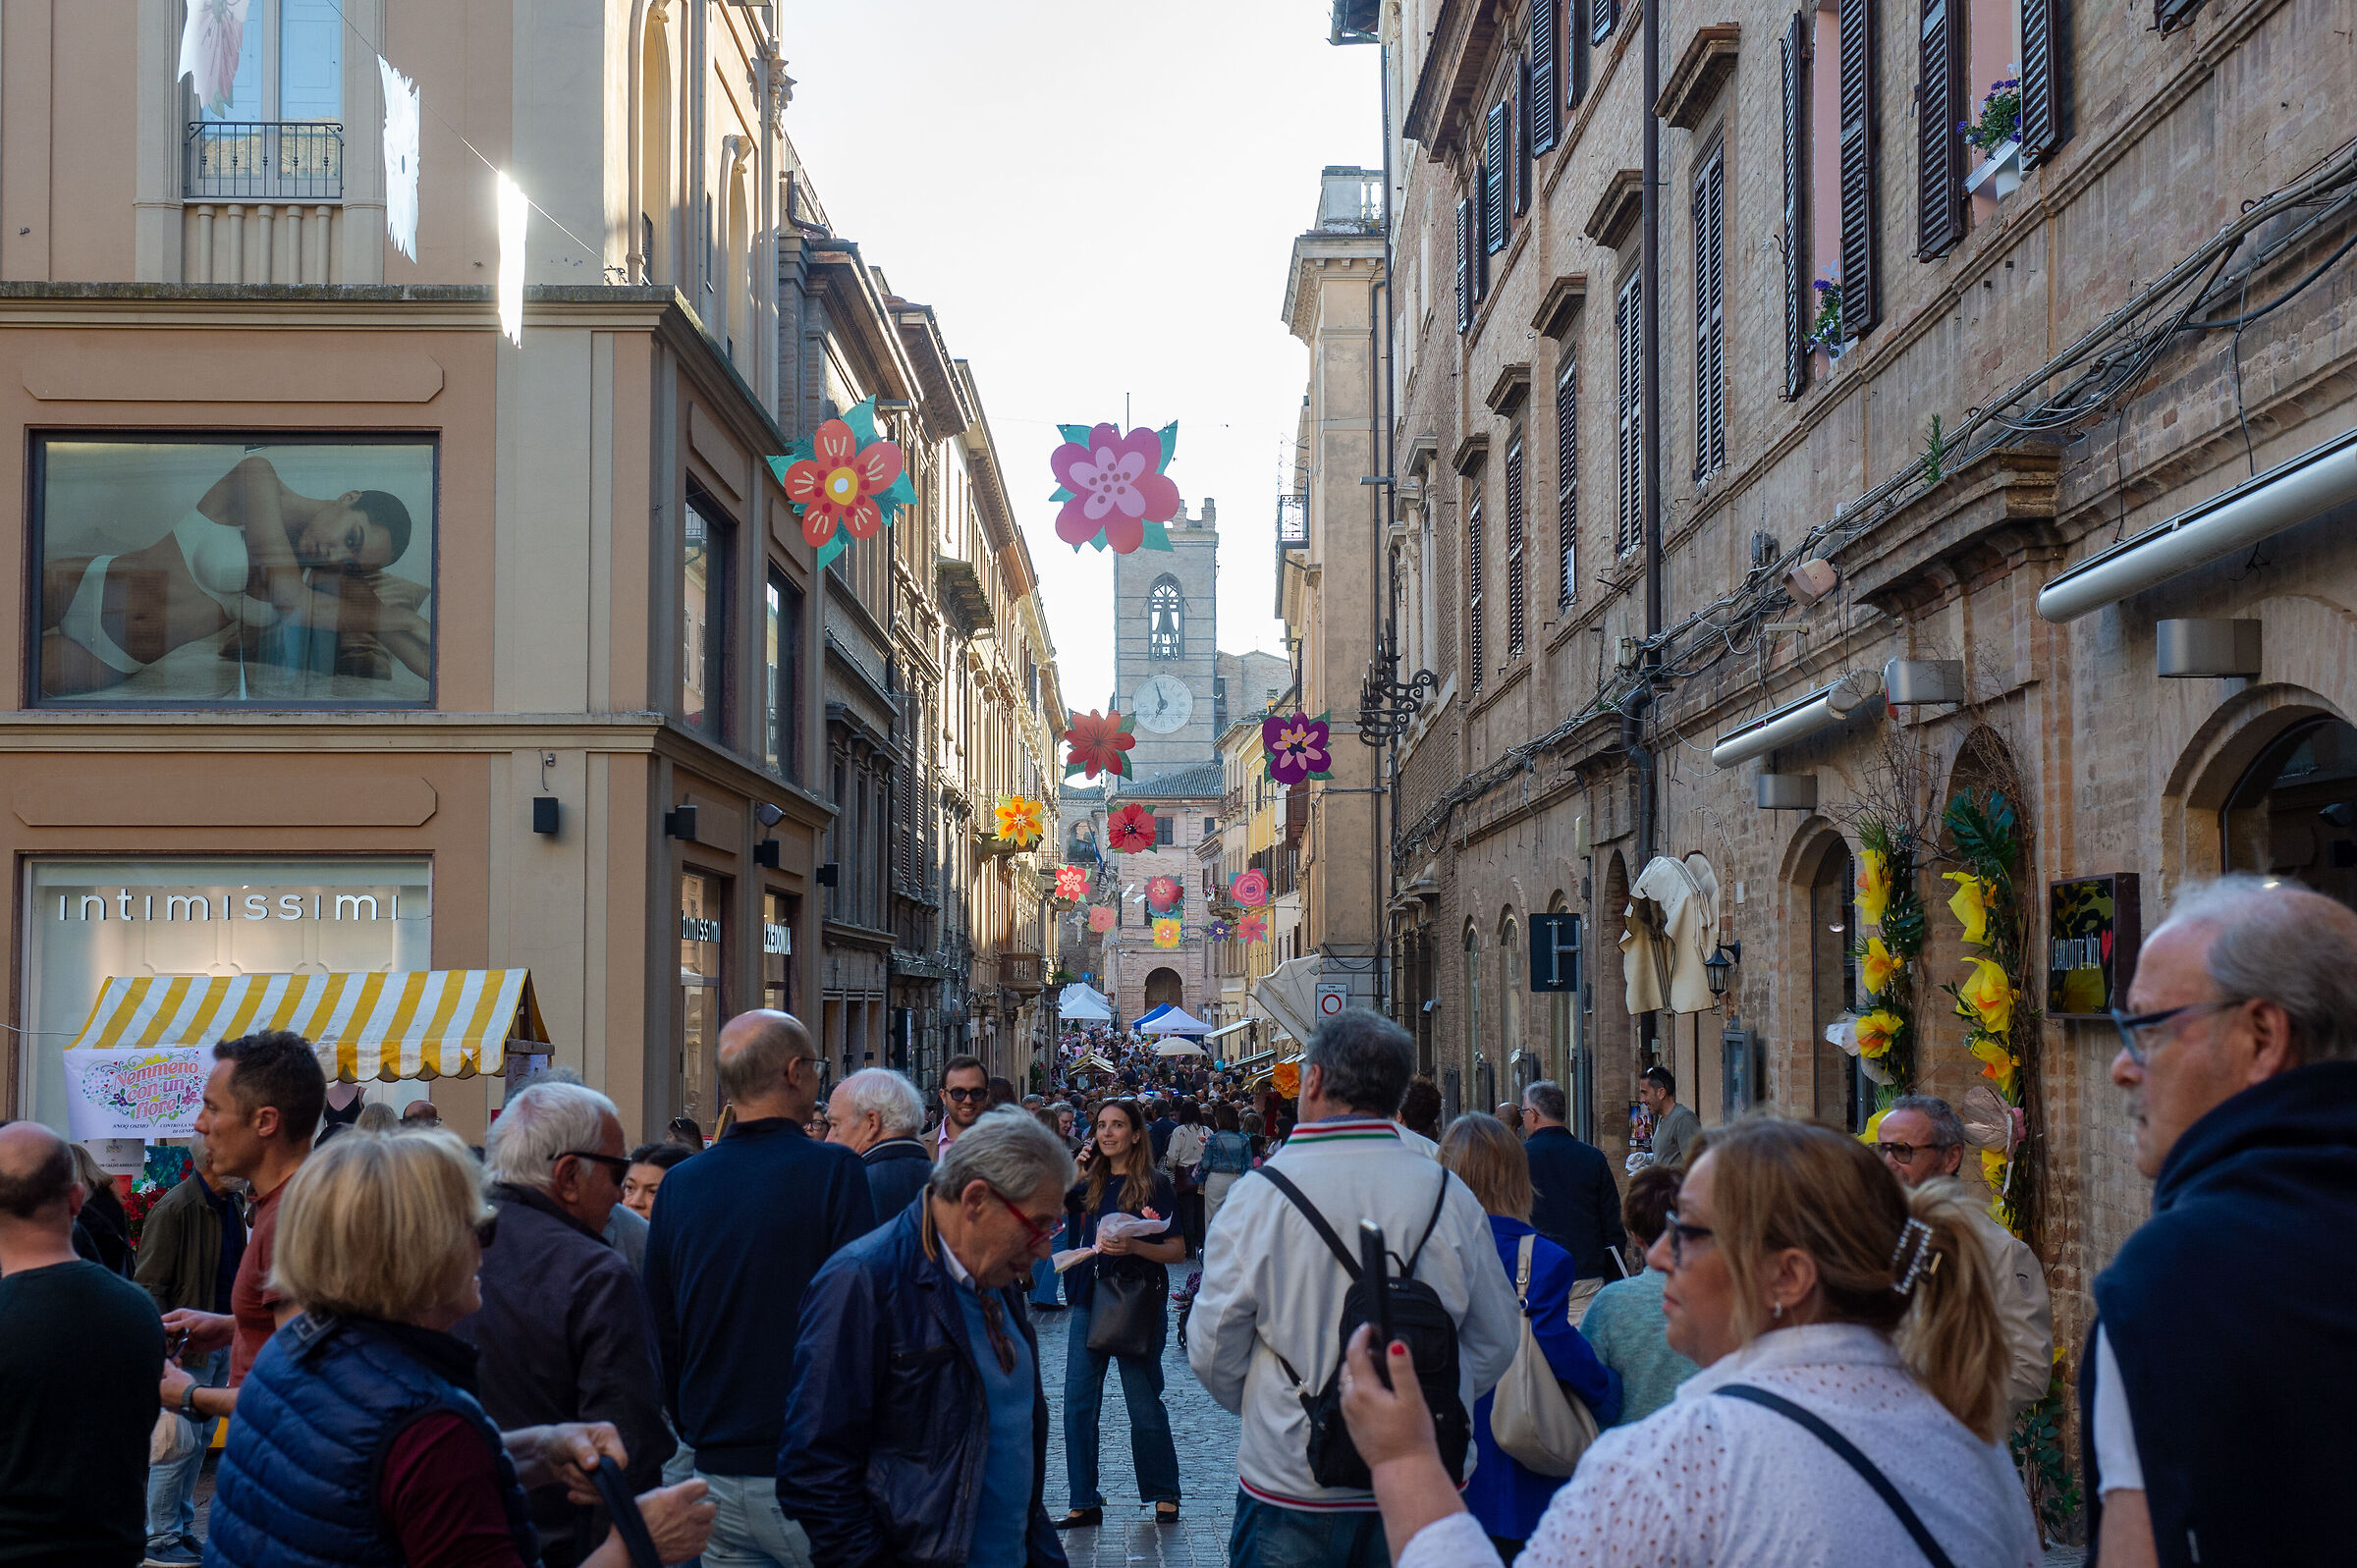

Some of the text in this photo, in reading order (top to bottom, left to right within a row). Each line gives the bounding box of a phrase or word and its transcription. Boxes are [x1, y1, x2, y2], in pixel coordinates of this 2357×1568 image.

[59, 889, 399, 921] intimissimi
[113, 1060, 198, 1091] Nemmeno
[127, 1078, 185, 1103] con un
[135, 1093, 181, 1120] fiore!
